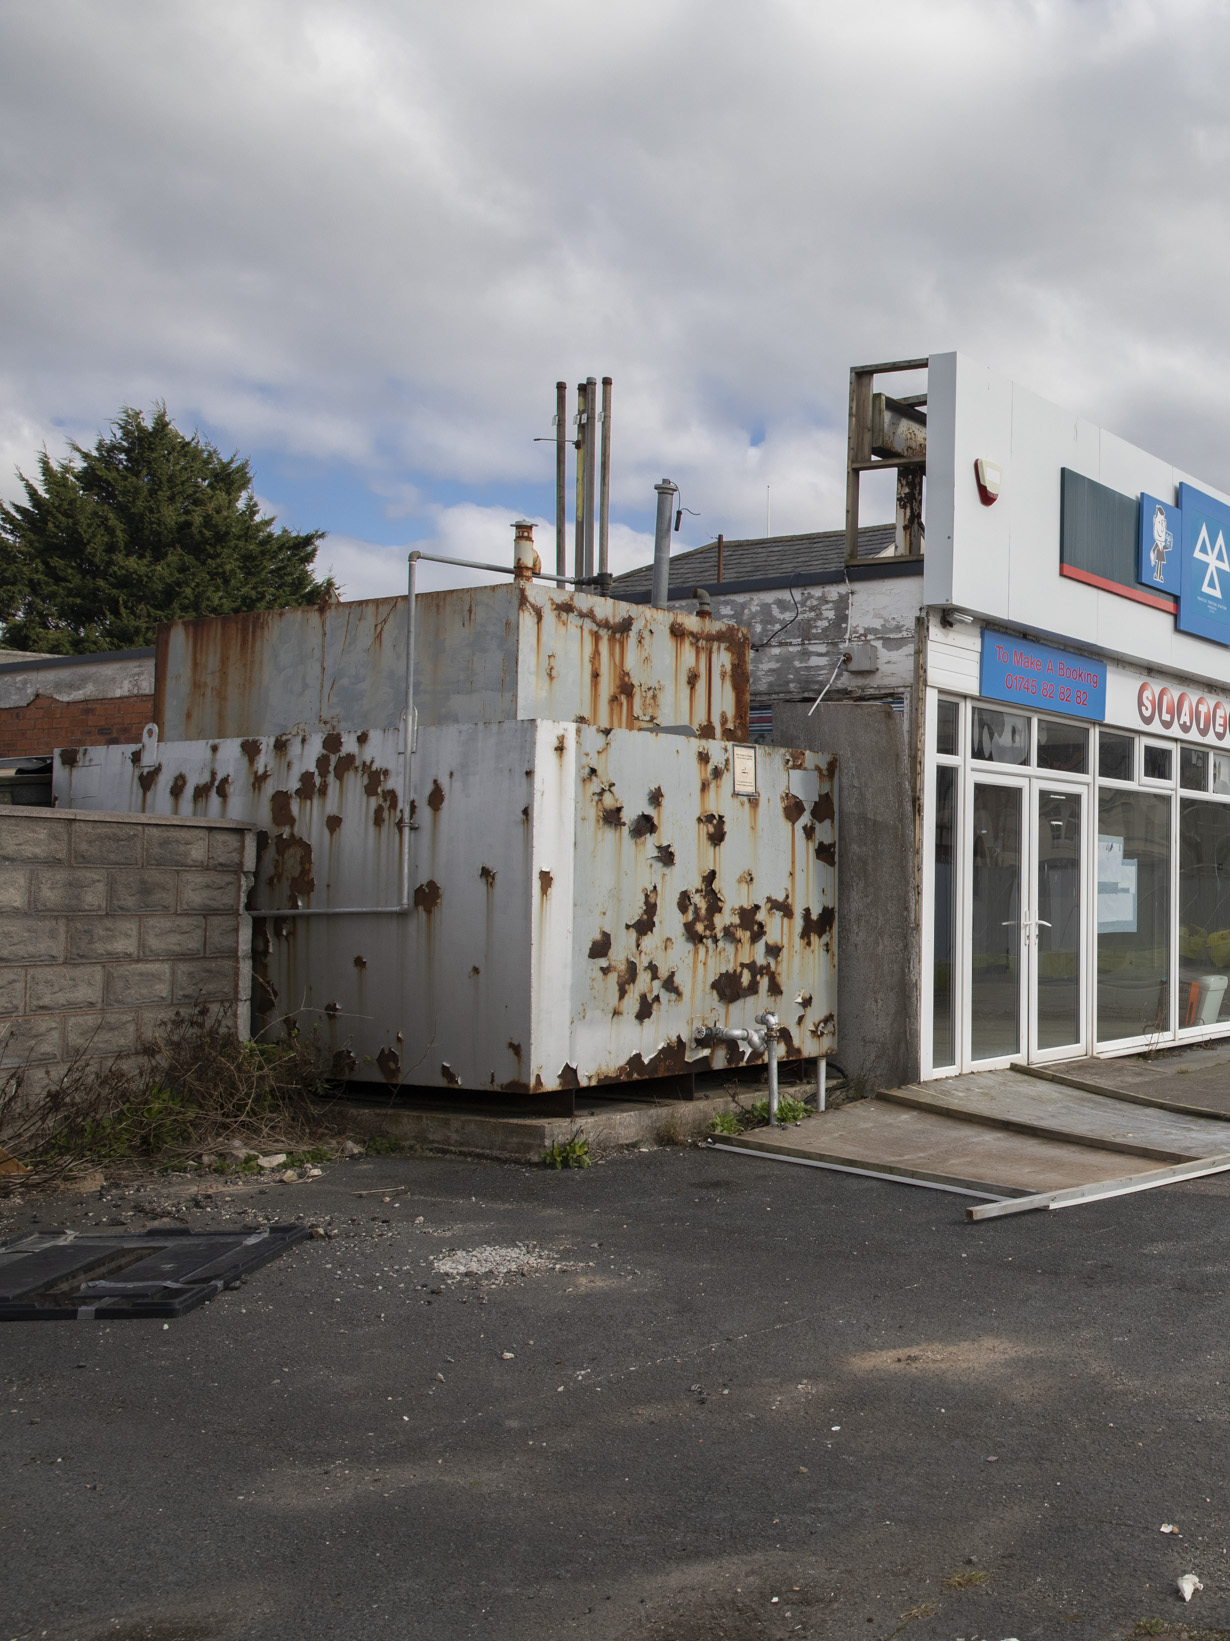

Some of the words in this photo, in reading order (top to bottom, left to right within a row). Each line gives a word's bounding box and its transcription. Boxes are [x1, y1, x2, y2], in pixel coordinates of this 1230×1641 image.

[995, 645, 1009, 663] To
[1013, 649, 1042, 671] Make
[1046, 659, 1054, 675] A
[1058, 661, 1099, 688] Booking
[1005, 673, 1038, 695] 01745
[1041, 681, 1055, 699] 82
[1058, 686, 1072, 703] 82
[1075, 689, 1088, 706] 82
